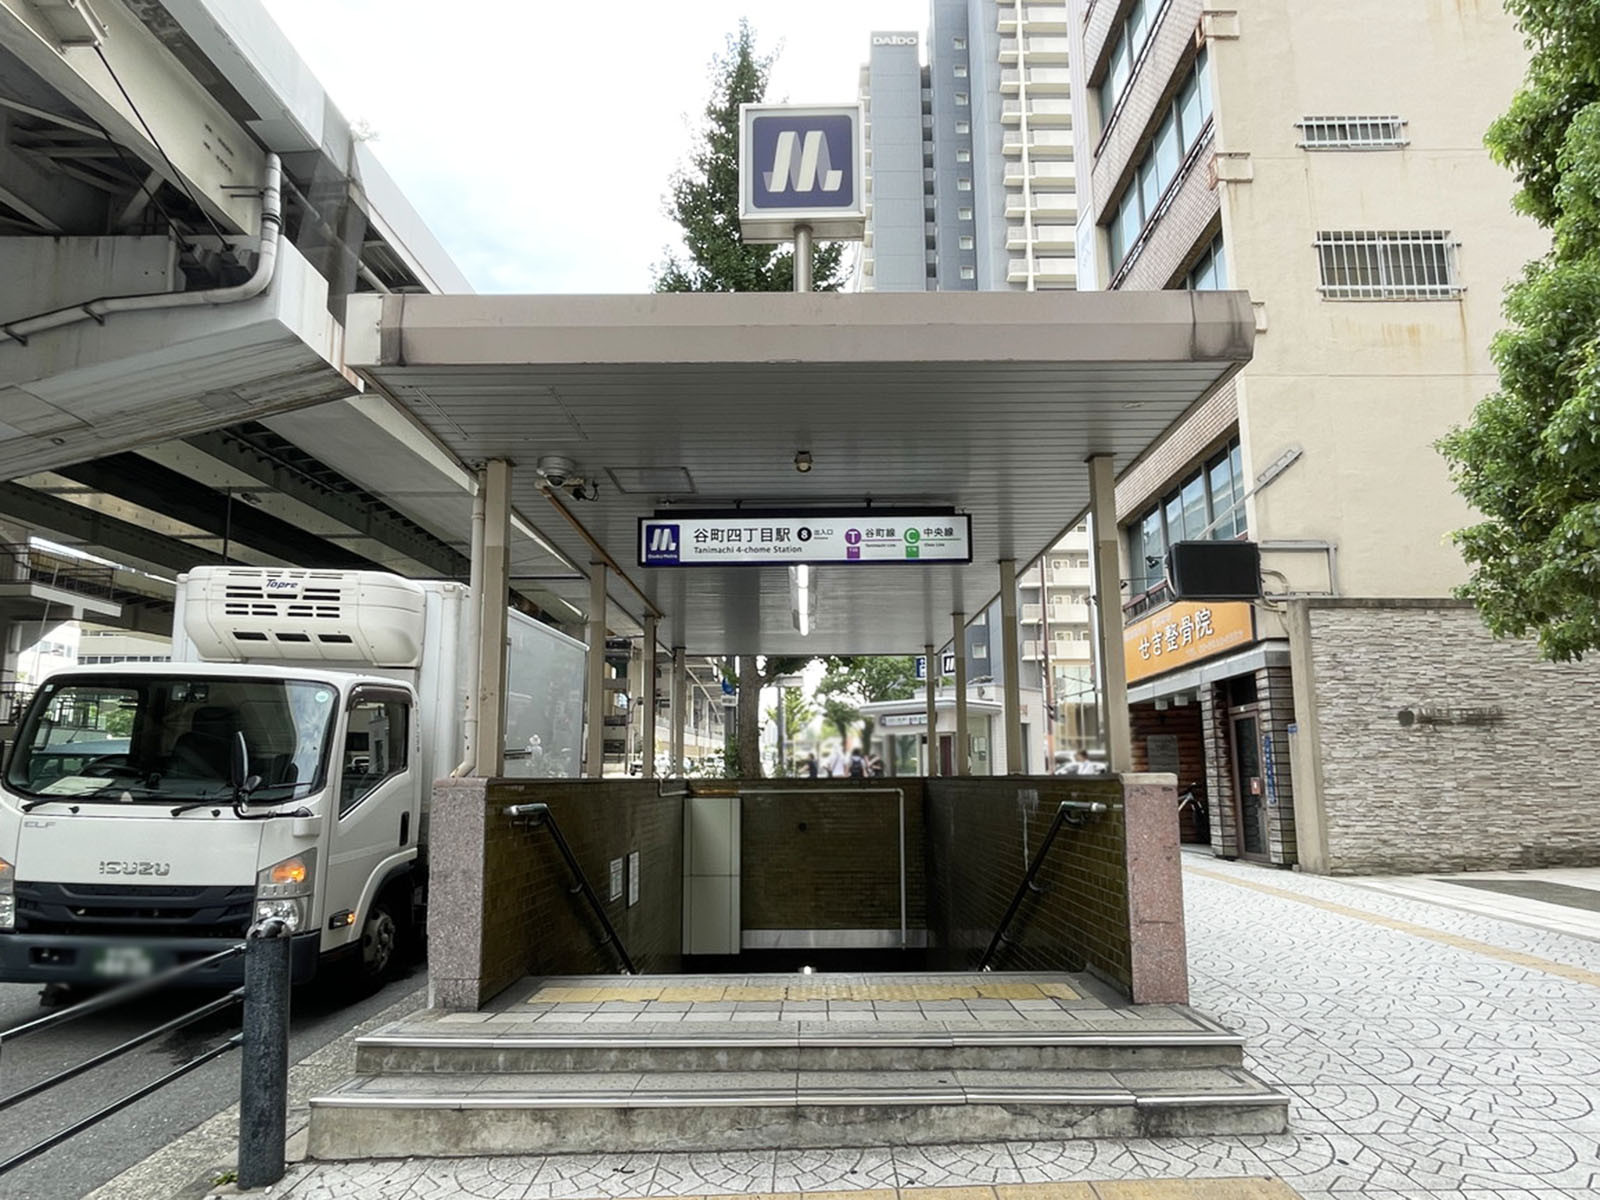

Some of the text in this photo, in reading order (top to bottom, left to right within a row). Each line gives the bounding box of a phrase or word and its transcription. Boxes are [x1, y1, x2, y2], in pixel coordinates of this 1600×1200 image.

[693, 527, 791, 543] 谷町四丁目駅
[865, 528, 896, 538] 谷町線
[923, 527, 954, 538] 中央線
[693, 545, 802, 554] Tanimachi 4-chome Station
[266, 579, 298, 589] Topre
[1138, 607, 1214, 660] せき整骨院
[99, 861, 171, 876] ISUZU
